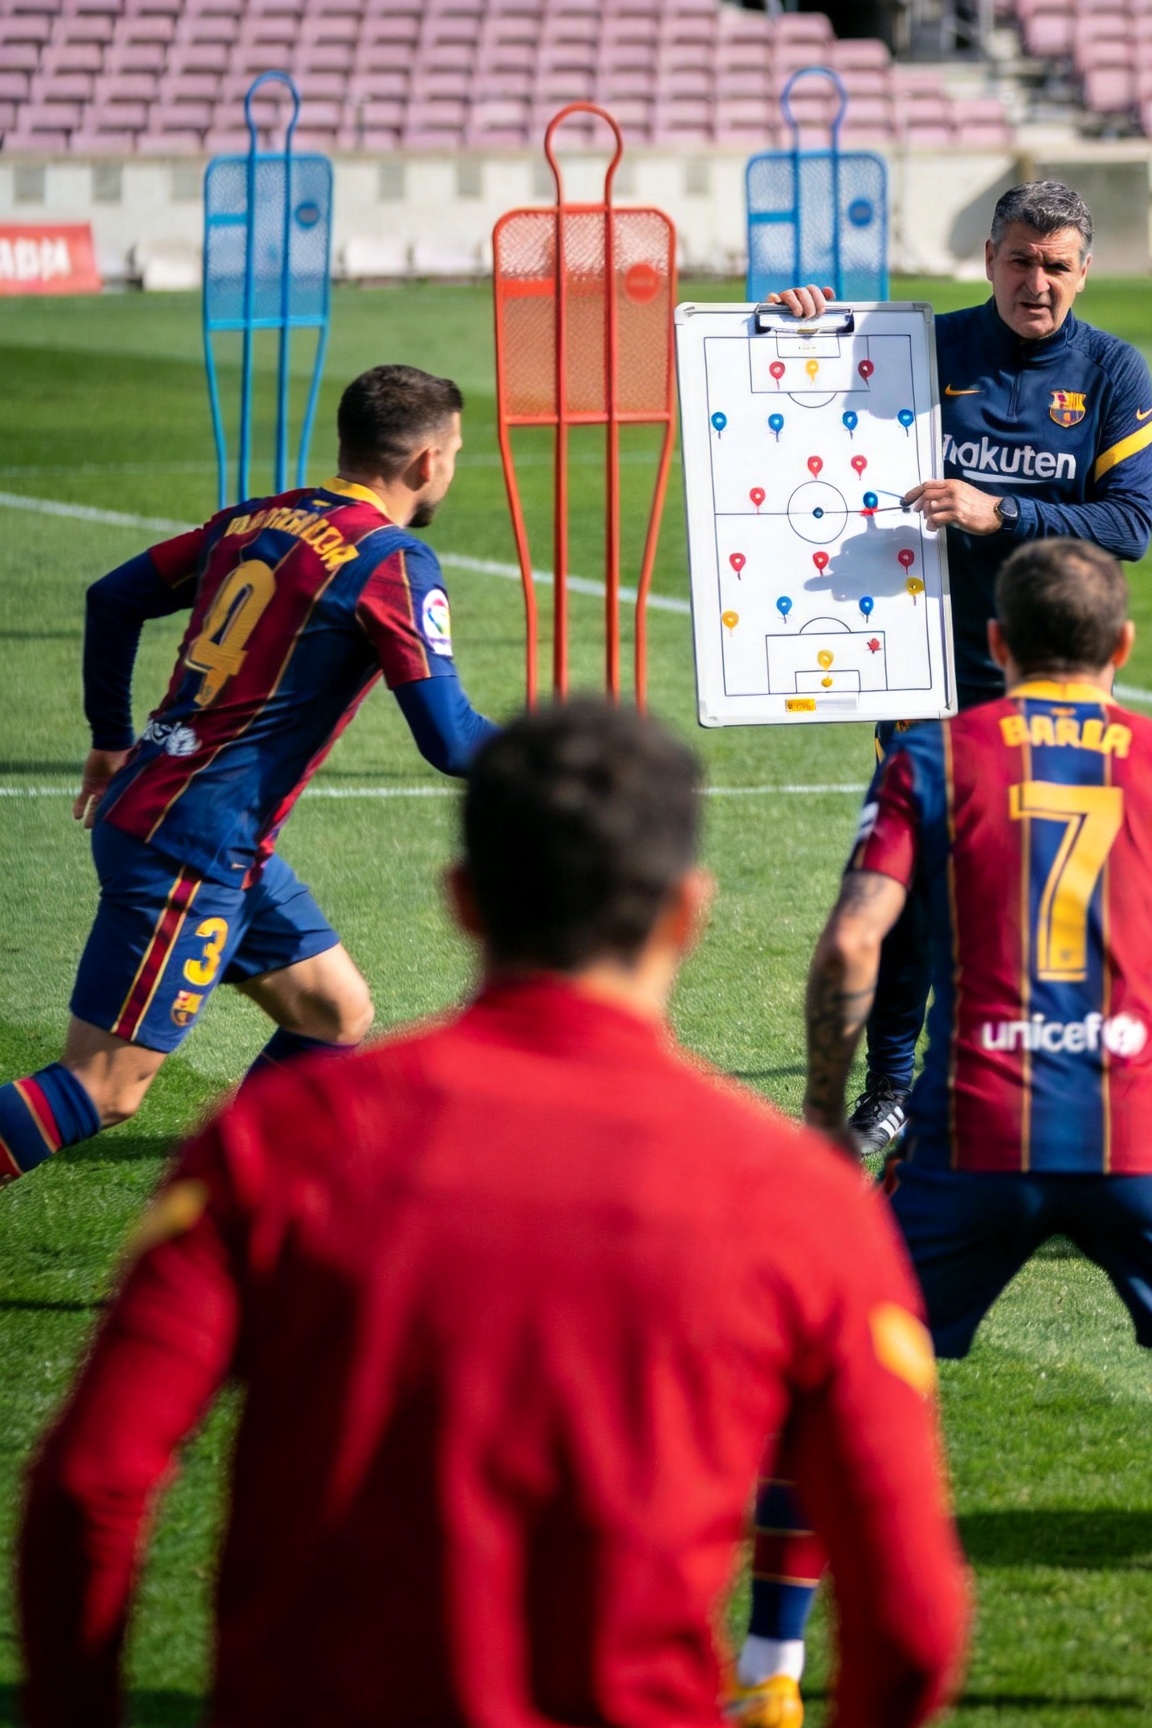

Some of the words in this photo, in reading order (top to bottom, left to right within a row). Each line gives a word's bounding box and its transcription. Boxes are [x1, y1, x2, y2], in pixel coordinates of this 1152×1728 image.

[1009, 781, 1123, 982] 7
[182, 917, 229, 986] 3
[981, 1011, 1103, 1053] unicef
